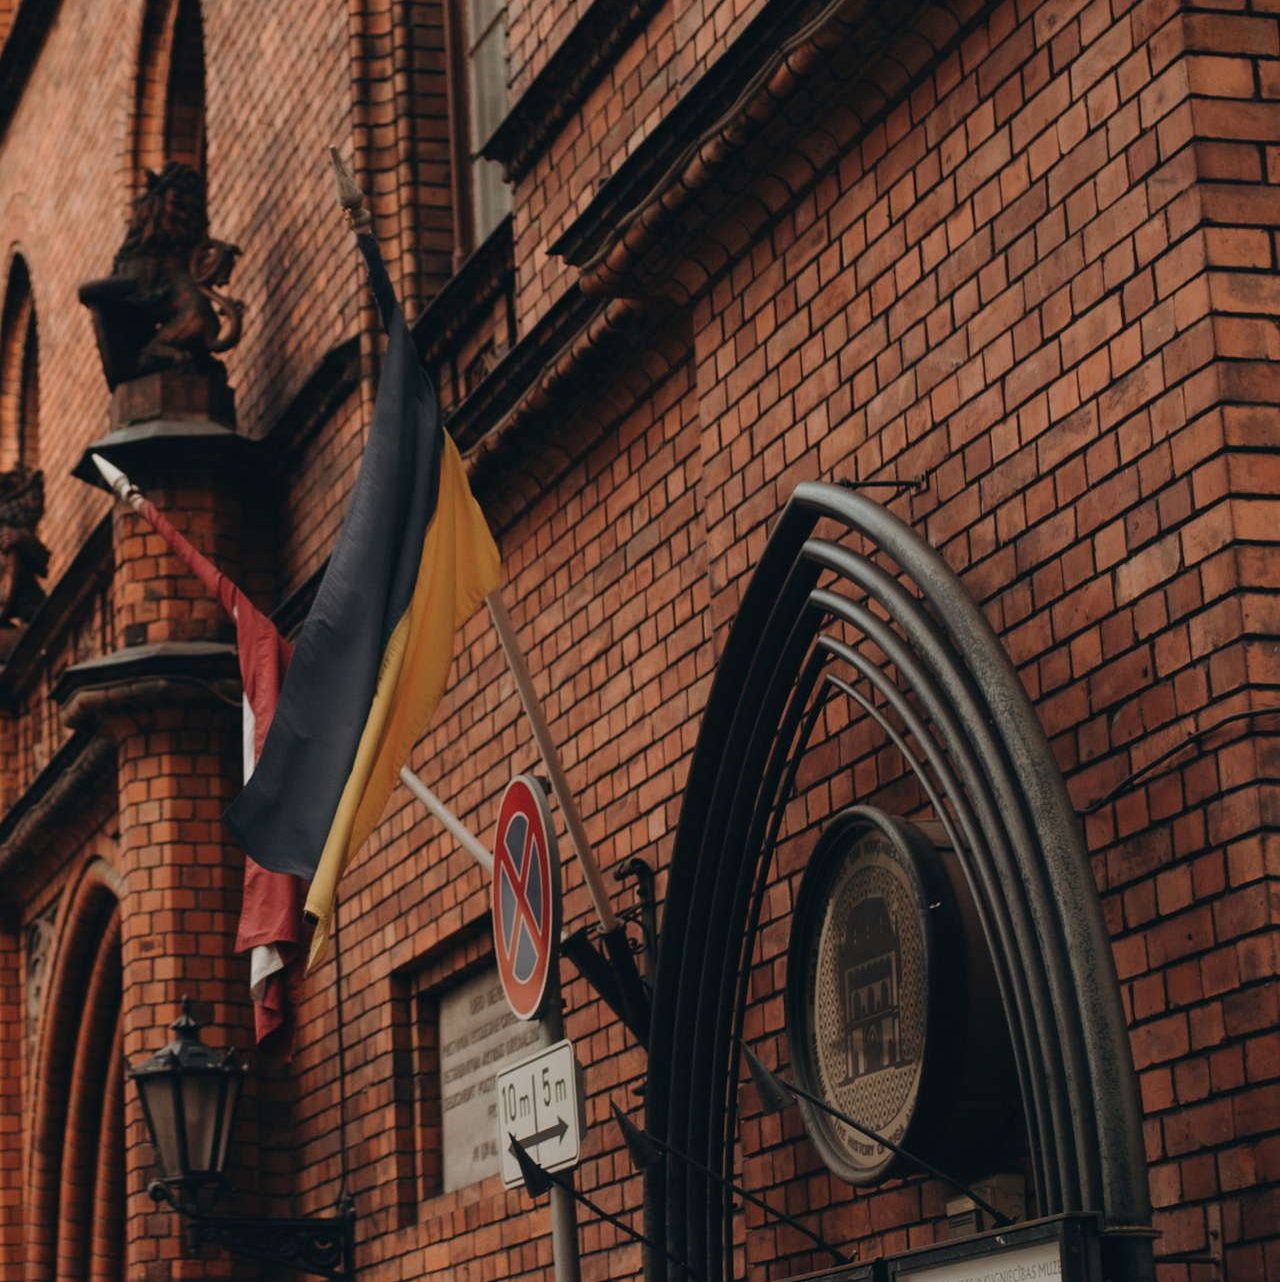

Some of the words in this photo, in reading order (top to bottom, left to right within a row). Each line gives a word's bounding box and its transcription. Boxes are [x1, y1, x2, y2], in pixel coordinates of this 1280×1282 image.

[502, 1082, 517, 1125] 10
[520, 1094, 531, 1119] m
[542, 1066, 552, 1107] 5
[555, 1077, 567, 1103] m
[834, 1118, 847, 1141] THE
[847, 1134, 875, 1157] HISTORY
